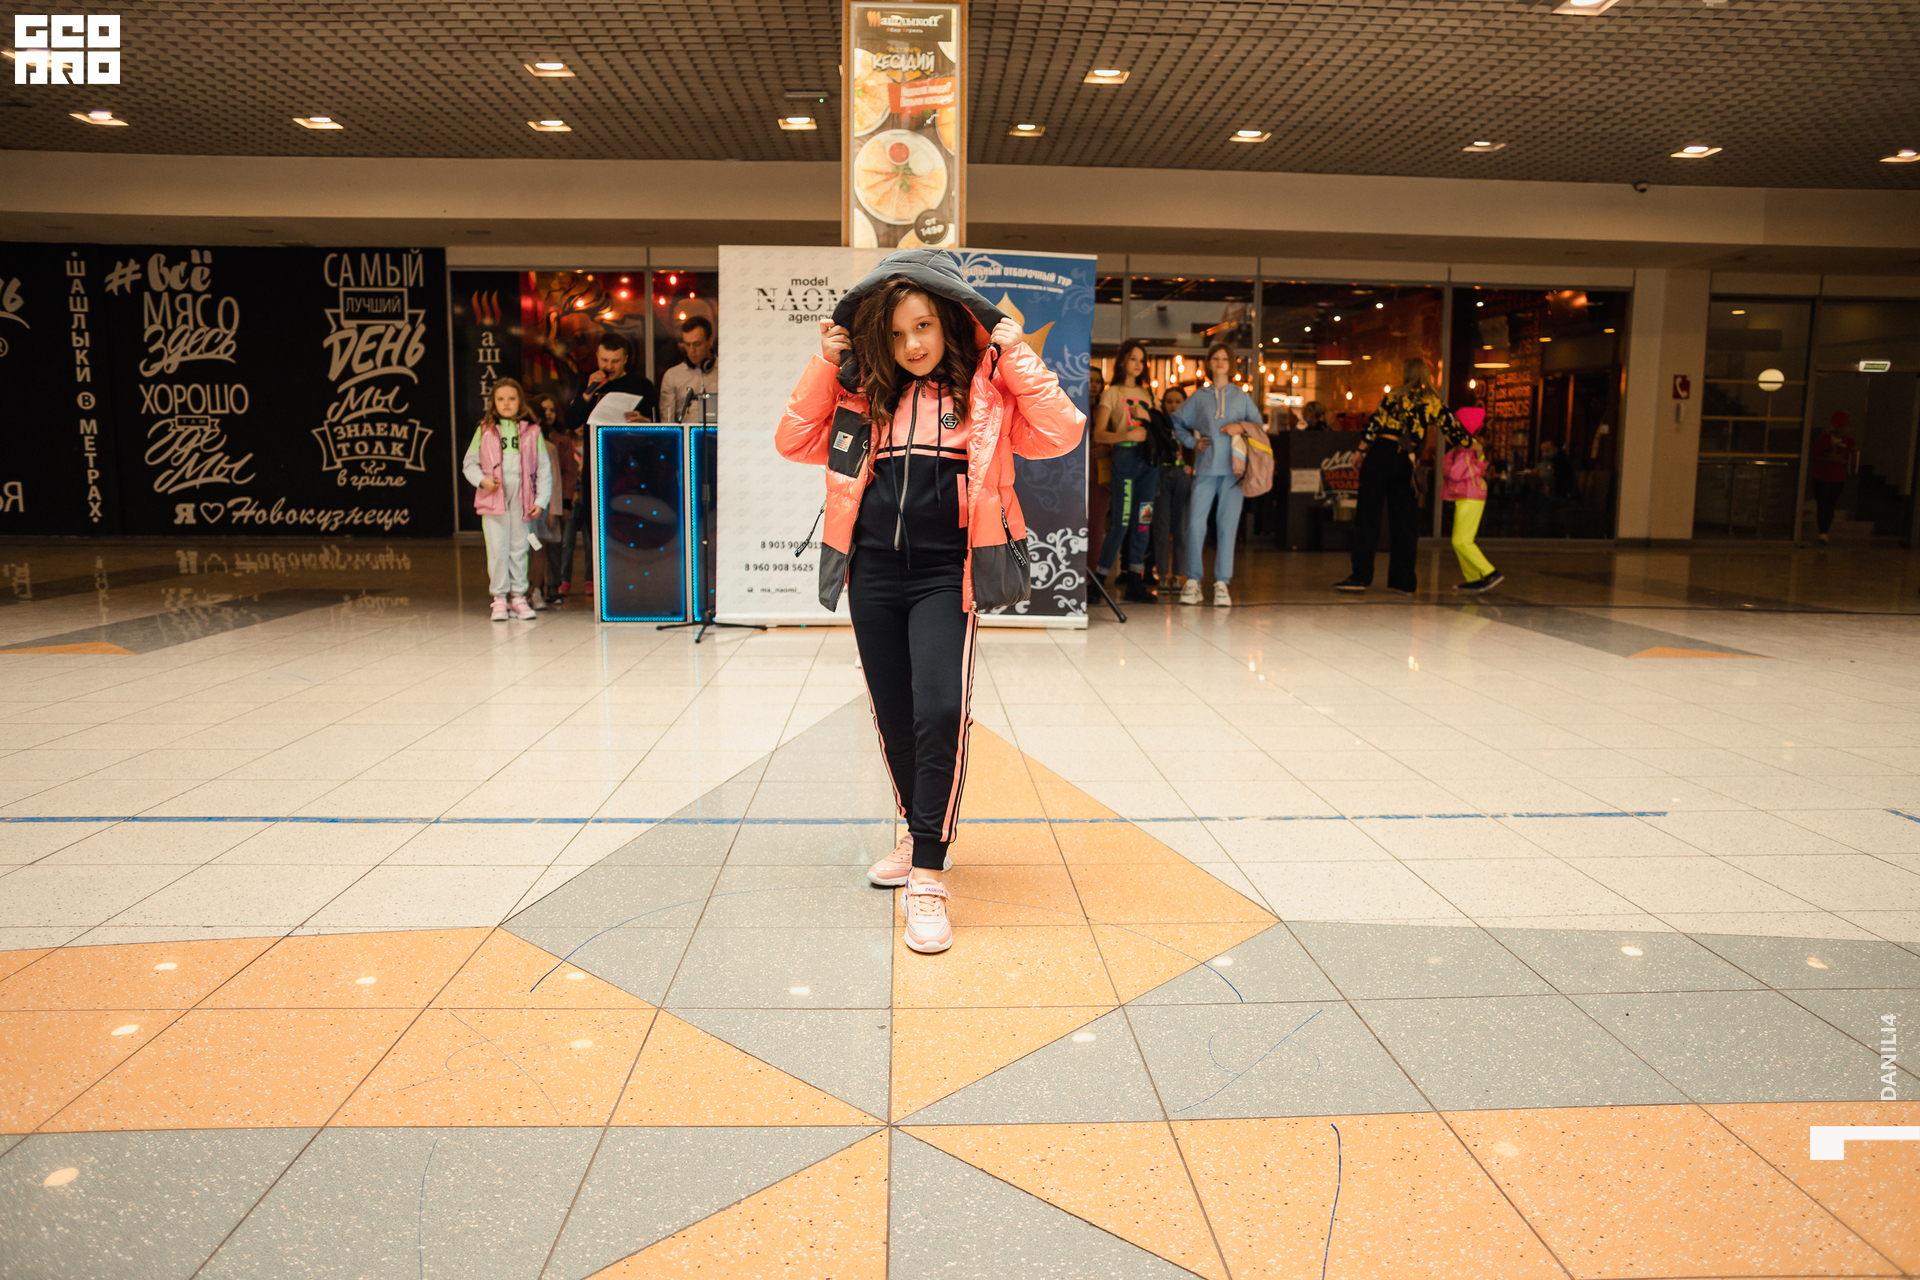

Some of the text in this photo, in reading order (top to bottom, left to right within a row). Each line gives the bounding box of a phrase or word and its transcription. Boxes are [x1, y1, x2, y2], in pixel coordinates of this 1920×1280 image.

[323, 248, 424, 288] САМЫЙ
[1003, 267, 1056, 283] ОТБОРОЧНЫЙ
[1057, 275, 1073, 287] ТУР
[791, 277, 828, 286] model
[143, 291, 240, 334] МЯСО
[345, 294, 401, 314] ЛУЧШИЙ
[65, 259, 92, 383] ШАШЛЫКИ
[139, 384, 249, 414] ХОРОШО
[333, 422, 409, 440] ЗНАЕМ
[336, 441, 406, 457] ТОЛК
[79, 419, 102, 518] МЕТРАХ
[350, 474, 406, 491] гриле
[174, 497, 410, 531] Я Новокузнецк
[760, 541, 766, 549] 8
[768, 541, 785, 549] 903
[744, 563, 814, 571] 8 960 908 5625
